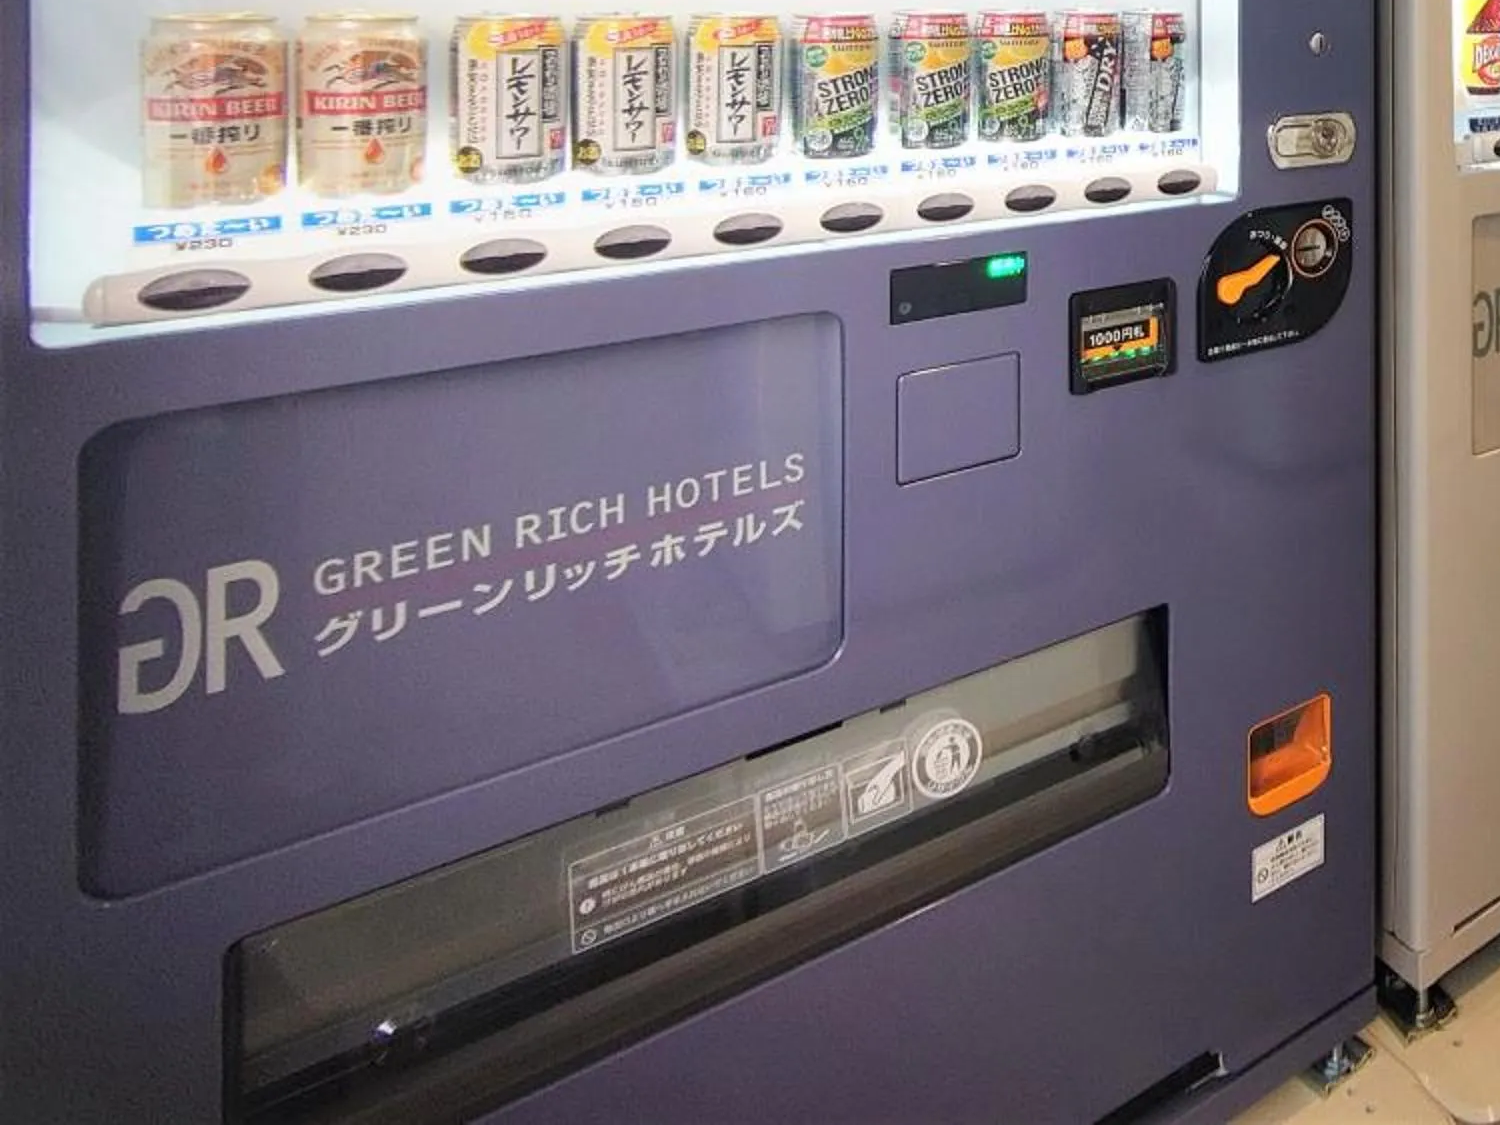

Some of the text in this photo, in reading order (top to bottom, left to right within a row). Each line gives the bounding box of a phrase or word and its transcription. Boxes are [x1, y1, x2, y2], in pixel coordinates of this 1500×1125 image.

[506, 56, 537, 151] レモンサワー
[621, 54, 650, 144] レモンサワー
[725, 52, 751, 135] レモンサワー
[152, 100, 216, 118] KIRIN
[314, 96, 377, 114] KIRIN
[169, 123, 262, 145] 一番搾り
[331, 116, 413, 137] 一番搾り
[337, 224, 387, 236] ¥230
[175, 238, 234, 252] ¥230
[312, 452, 806, 597] GREEN RICH HOTELS
[314, 499, 806, 658] グリーンリッチホテルズ
